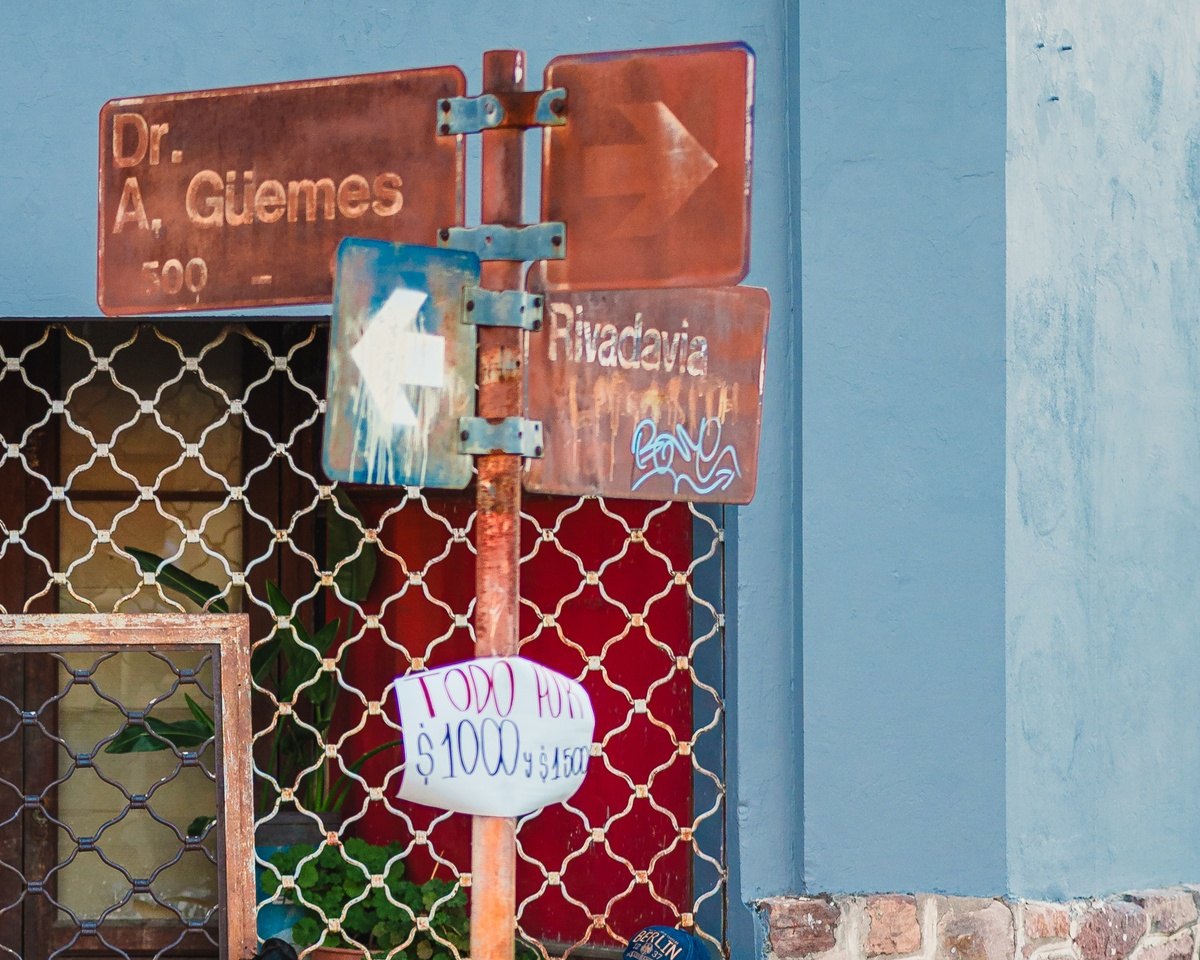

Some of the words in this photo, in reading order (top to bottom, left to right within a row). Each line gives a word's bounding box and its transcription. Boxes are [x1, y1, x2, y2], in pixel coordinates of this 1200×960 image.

[112, 112, 183, 168] Dr.
[112, 176, 163, 236] A.
[185, 169, 404, 228] Güemes
[548, 302, 708, 376] Rivadavia
[404, 660, 515, 718] TODO
[416, 718, 520, 785] $1000
[633, 930, 683, 960] BERLIN
